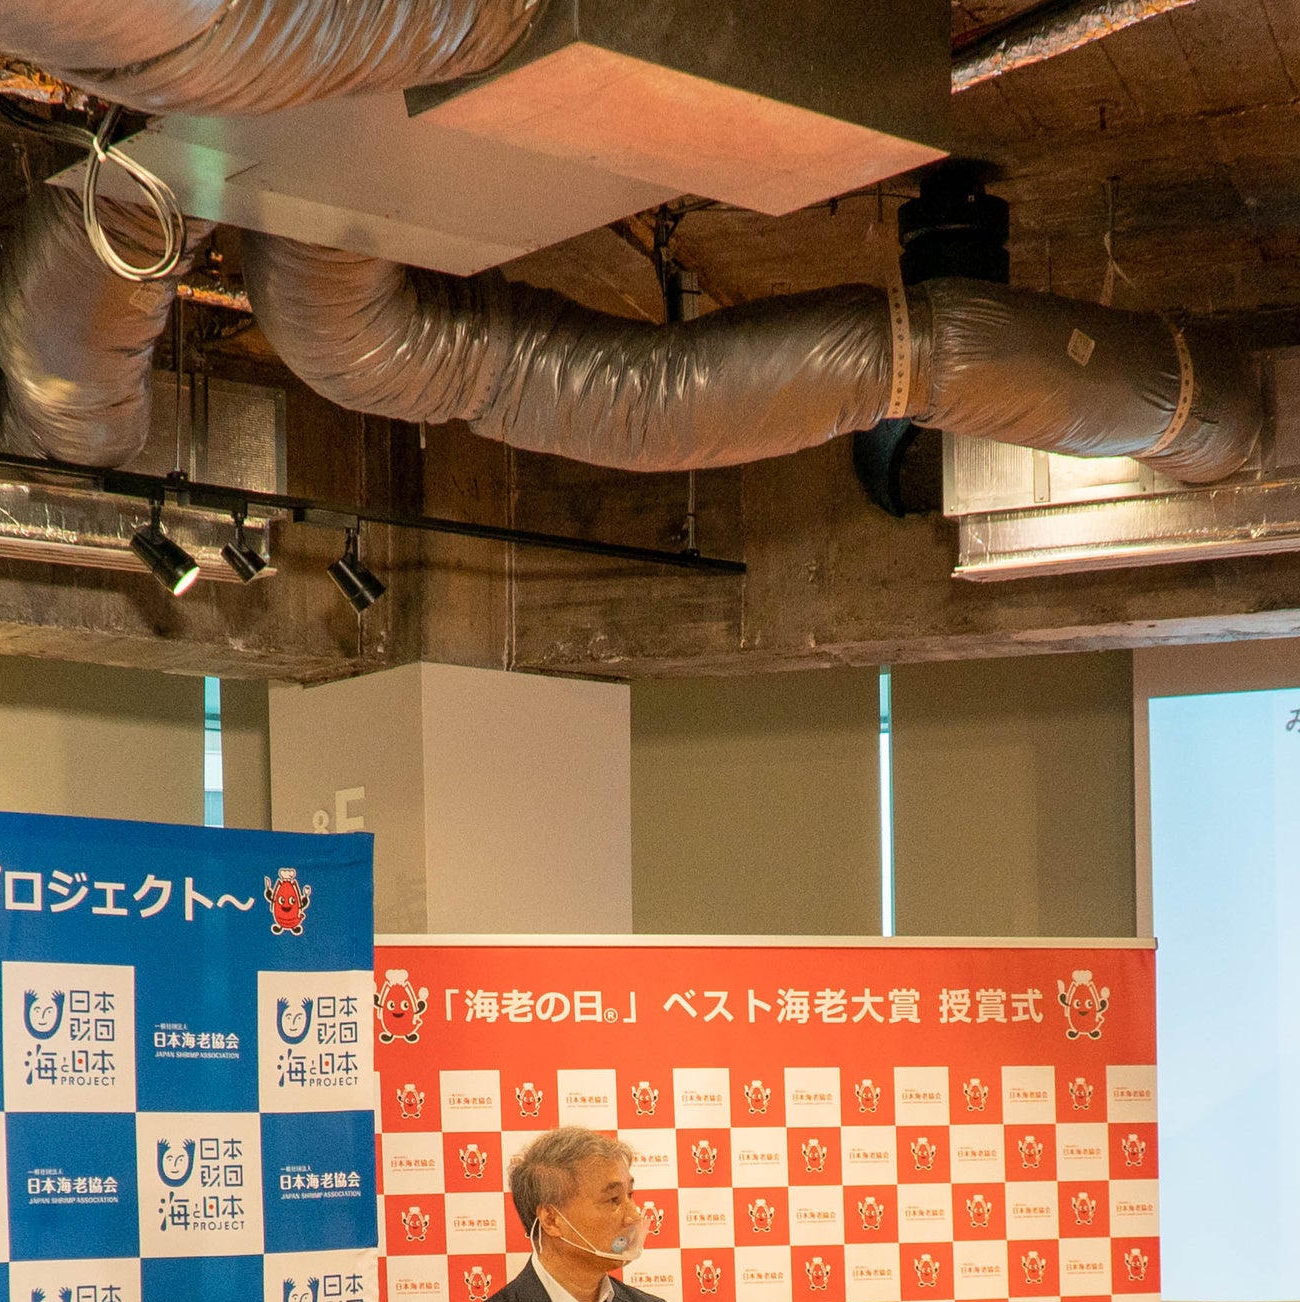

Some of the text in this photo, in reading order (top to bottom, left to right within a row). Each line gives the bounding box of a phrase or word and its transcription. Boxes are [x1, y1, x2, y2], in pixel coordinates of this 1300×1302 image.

[69, 989, 115, 1014] 日本
[317, 995, 358, 1019] 日本
[938, 988, 1044, 1024] 授賞式
[69, 1017, 115, 1042] 財団
[153, 1031, 240, 1050] 日本海老協会
[317, 1021, 358, 1045] 財団
[24, 1043, 116, 1086] 海と日本
[276, 1048, 358, 1088] 海と日本
[60, 1075, 116, 1087] PROJECT
[309, 1076, 358, 1088] PROJECT
[199, 1137, 243, 1161] 日本
[27, 1176, 118, 1195] 日本海老協会
[200, 1164, 244, 1188] 財団
[279, 1171, 361, 1191] 日本海老協会
[158, 1191, 245, 1232] 海と日本
[192, 1220, 245, 1231] PROJECT
[323, 1273, 364, 1297] 日本
